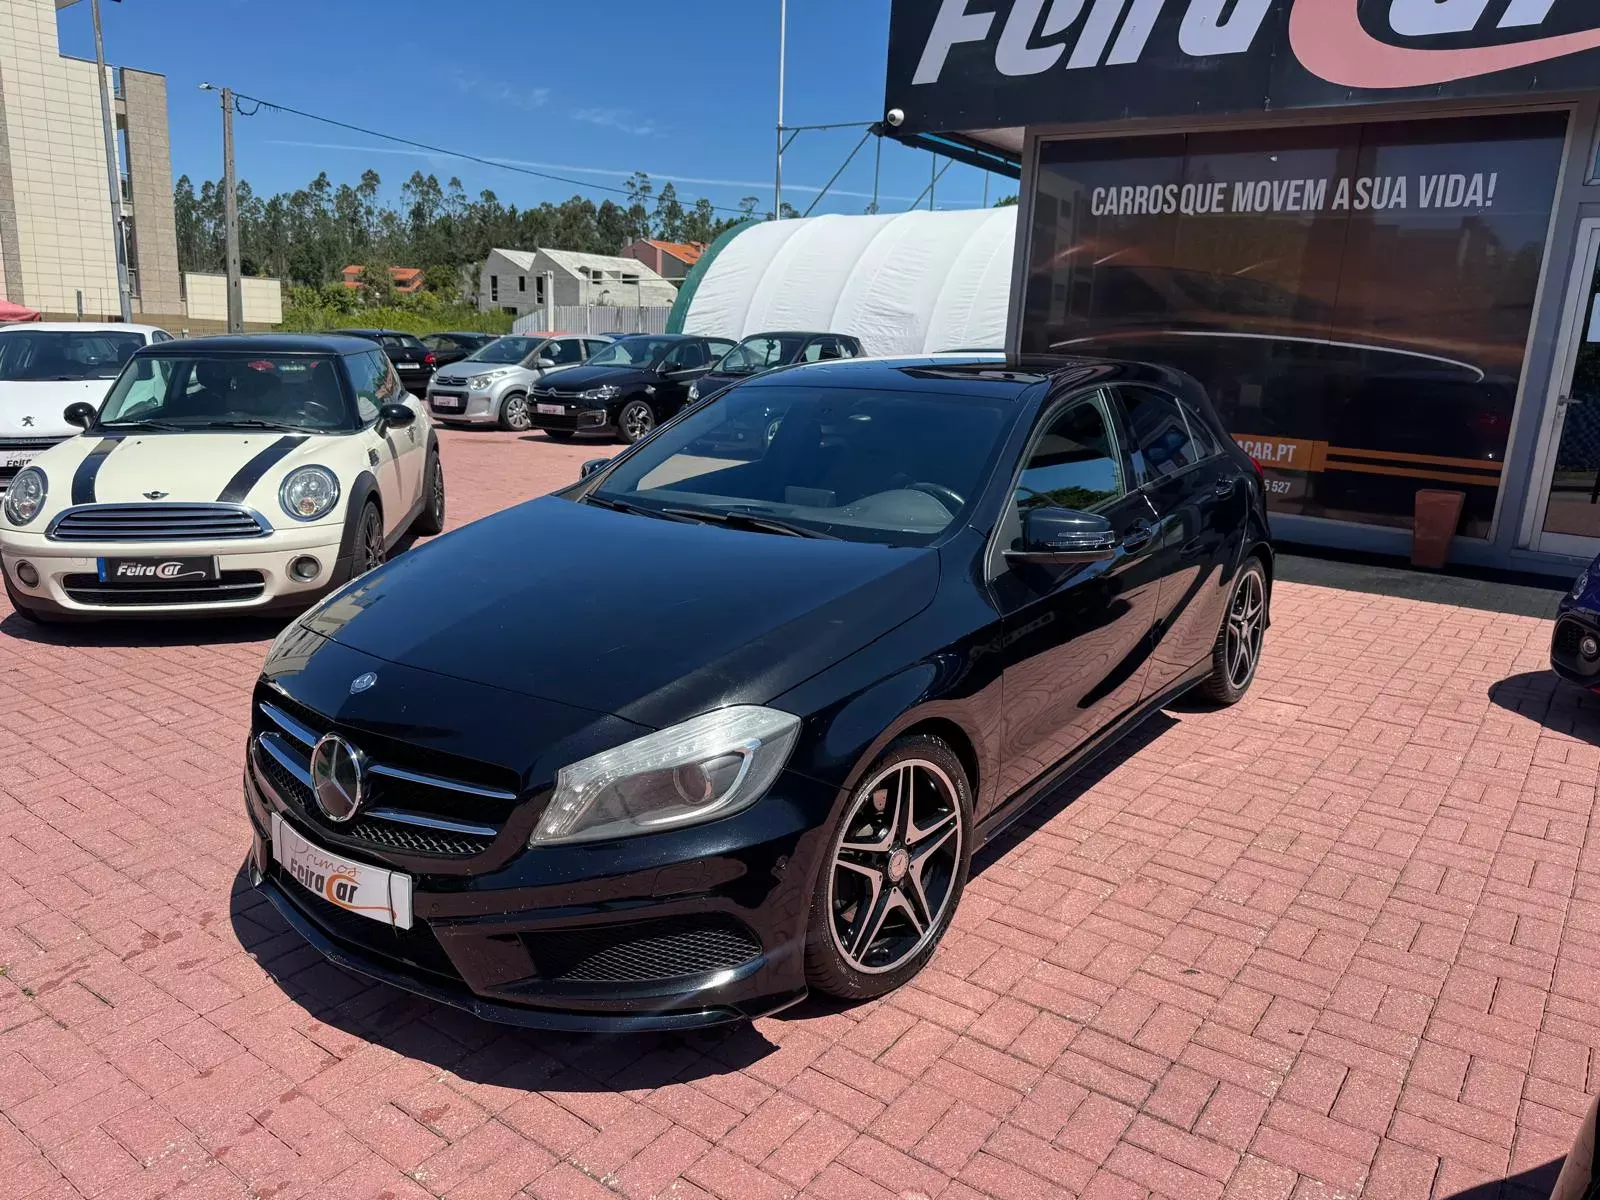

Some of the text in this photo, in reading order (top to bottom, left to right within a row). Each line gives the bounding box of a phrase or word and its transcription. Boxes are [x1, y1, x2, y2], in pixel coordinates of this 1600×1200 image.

[911, 0, 1600, 89] Feira
[1091, 173, 1498, 216] CARROS QUE MOVEM A SUA VIDA!
[1271, 480, 1292, 494] 527
[289, 838, 362, 877] Primos
